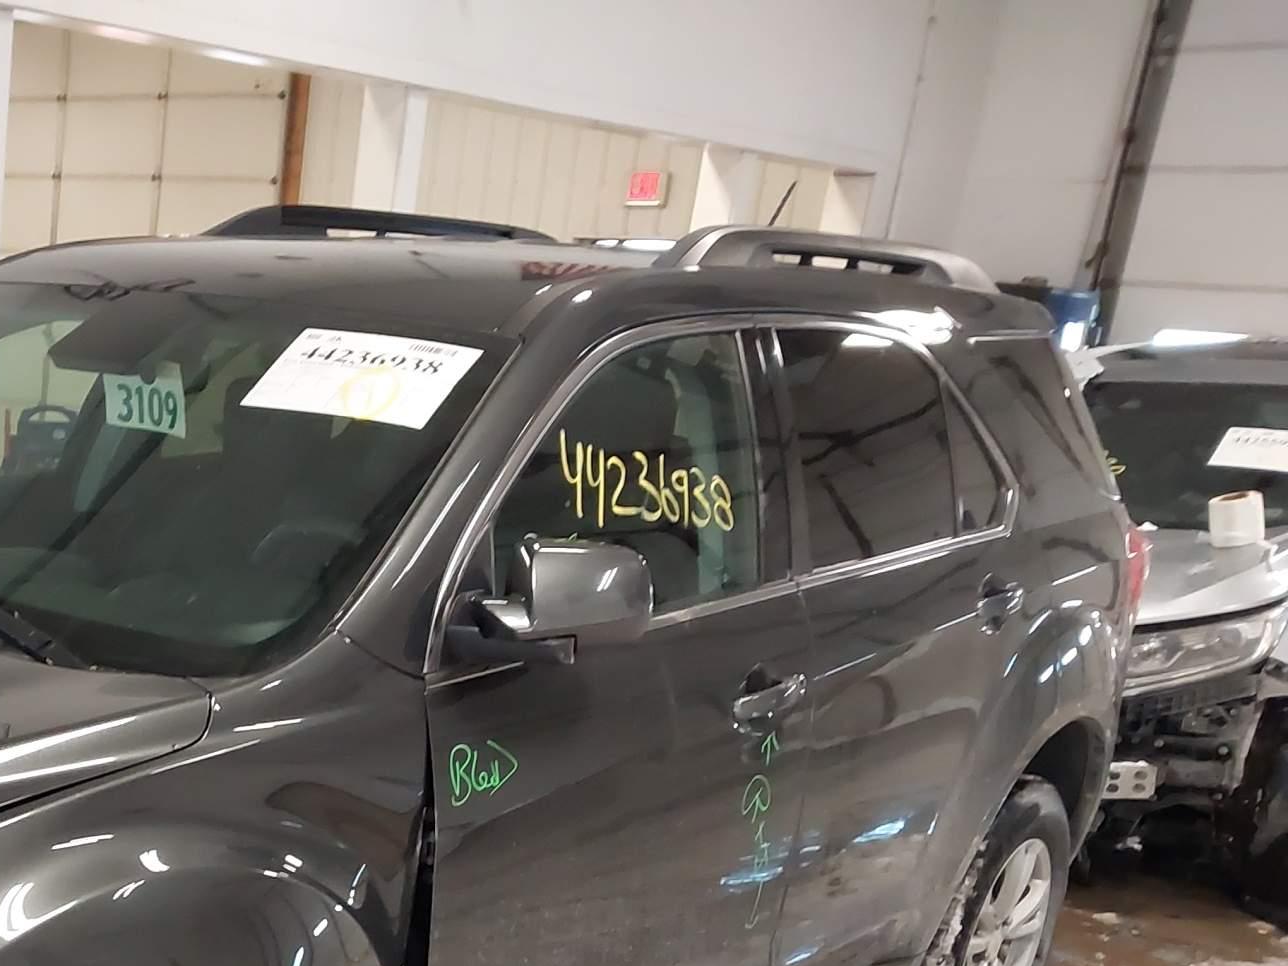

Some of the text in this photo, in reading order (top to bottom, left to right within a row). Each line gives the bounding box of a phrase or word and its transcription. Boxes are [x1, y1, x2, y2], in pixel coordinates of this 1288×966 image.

[300, 345, 444, 375] 44236938
[117, 383, 178, 430] 3109
[559, 428, 734, 531] 44236938
